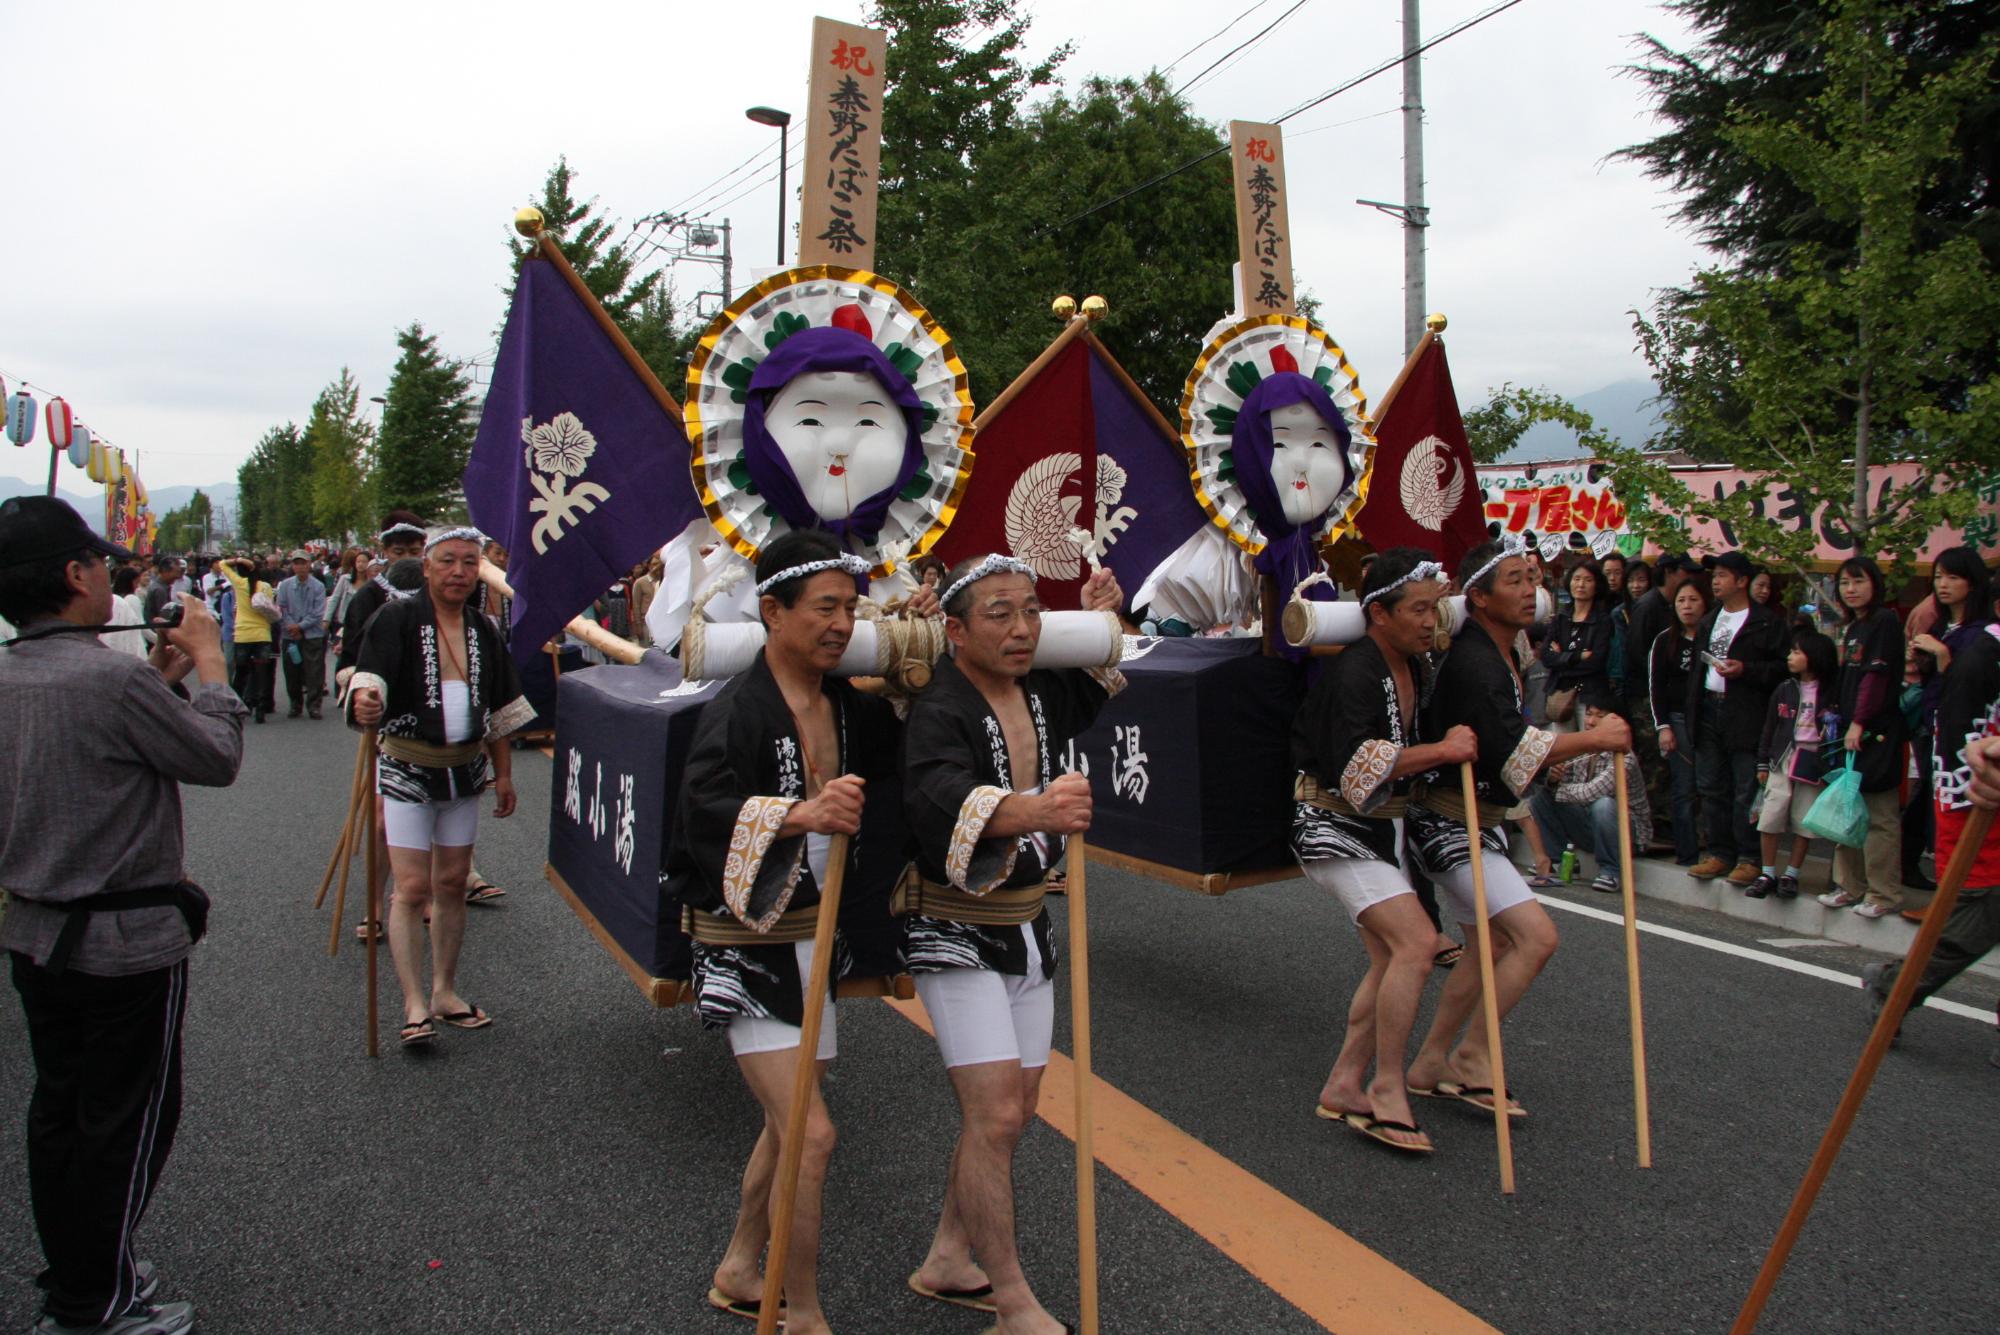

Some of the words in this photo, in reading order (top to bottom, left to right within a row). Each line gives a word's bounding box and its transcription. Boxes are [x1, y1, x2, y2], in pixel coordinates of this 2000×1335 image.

[829, 39, 875, 77] 祝
[816, 74, 872, 254] 秦野たばこ祭
[1245, 137, 1275, 163] 祝
[1247, 164, 1288, 308] 秦野たばこ祭
